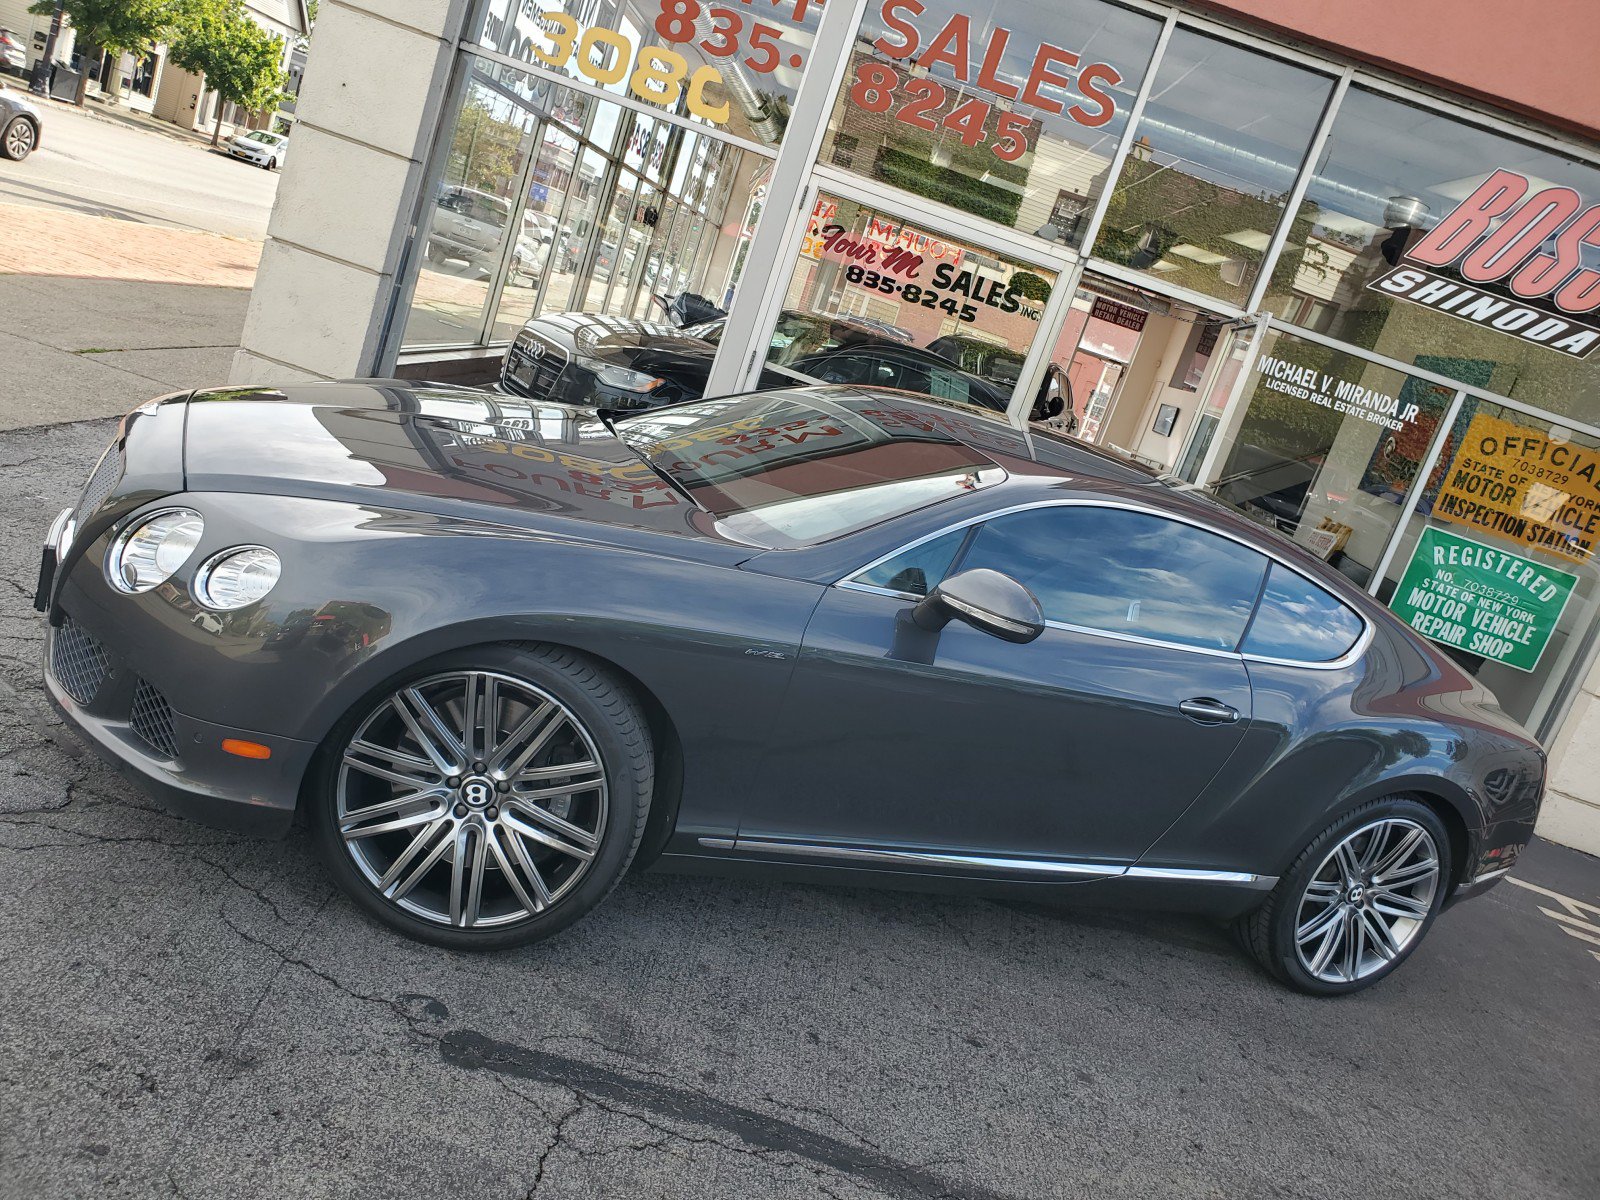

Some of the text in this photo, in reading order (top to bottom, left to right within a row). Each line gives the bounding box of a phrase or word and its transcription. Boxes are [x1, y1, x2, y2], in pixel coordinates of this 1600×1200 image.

[530, 10, 730, 123] 308C
[873, 0, 1124, 128] SALES
[850, 62, 1033, 161] 8245
[822, 224, 875, 265] Four
[931, 263, 1023, 313] SALES
[1094, 308, 1140, 331] RETAIL DEALER
[1095, 301, 1119, 314] MOTOR
[1119, 307, 1145, 323] VEHICLE
[1380, 270, 1600, 354] SHINODA
[1256, 354, 1420, 425] MICHAEL V. MIRANDA JR.
[1265, 378, 1404, 432] LICENSED REAL ESTATE BROKER
[1452, 469, 1517, 506] MOTOR
[1462, 458, 1504, 480] STATE
[1508, 473, 1529, 486] OF
[1512, 458, 1569, 485] 7038729
[1438, 493, 1592, 556] INSPECTION STATION
[1422, 577, 1536, 624] STATE OF NEW YORK
[1433, 545, 1558, 603] REGISTERED
[1463, 578, 1519, 605] 7038729
[1406, 587, 1537, 646] MOTOR VEHICLE
[1410, 610, 1514, 660] REPAIR SHOP
